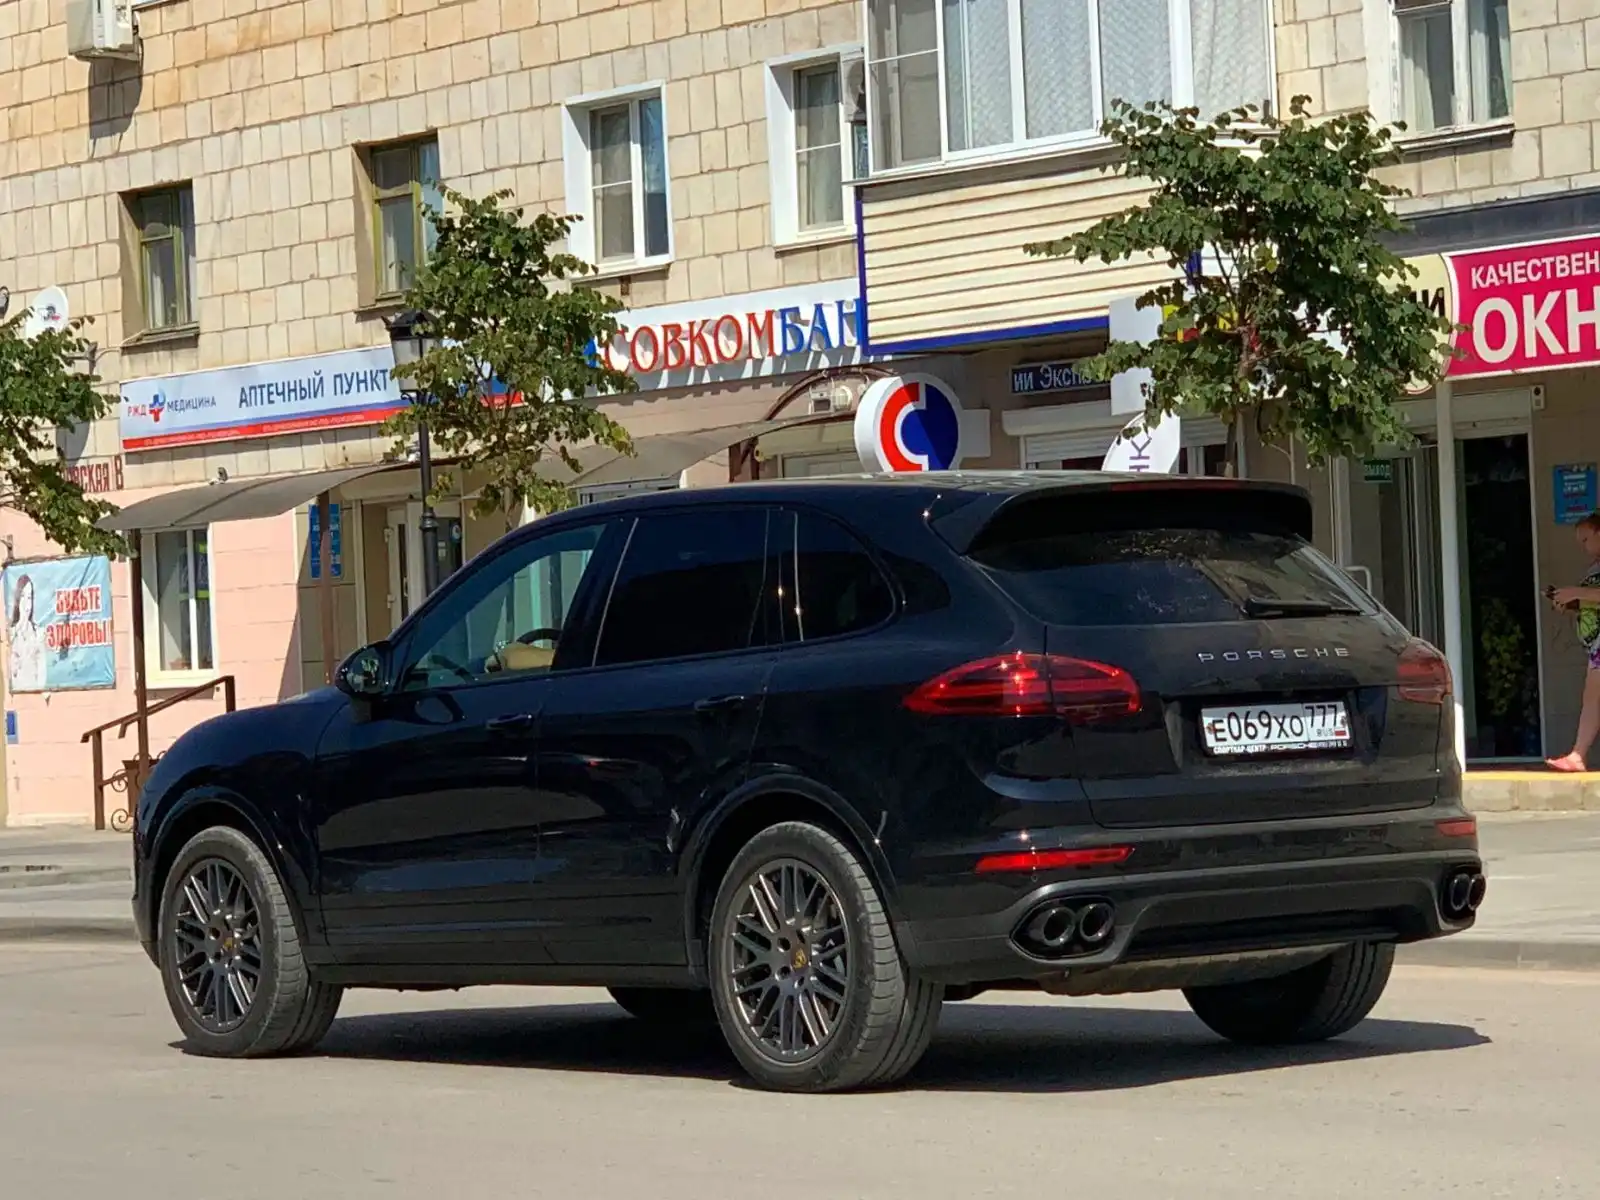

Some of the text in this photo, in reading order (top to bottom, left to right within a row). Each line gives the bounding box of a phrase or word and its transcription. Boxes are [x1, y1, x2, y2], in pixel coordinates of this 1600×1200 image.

[1471, 250, 1600, 289] КАЧЕСТВЕН
[1472, 286, 1600, 364] ОКН
[238, 368, 389, 408] АПТЕЧНЫЙ ПУНКТ
[127, 396, 217, 417] РЖД МЕДИЦИНА
[56, 587, 100, 613] БУДЬТЕ
[1198, 647, 1350, 662] PORSCHE
[1304, 704, 1338, 728] 777
[1316, 728, 1334, 738] RUS
